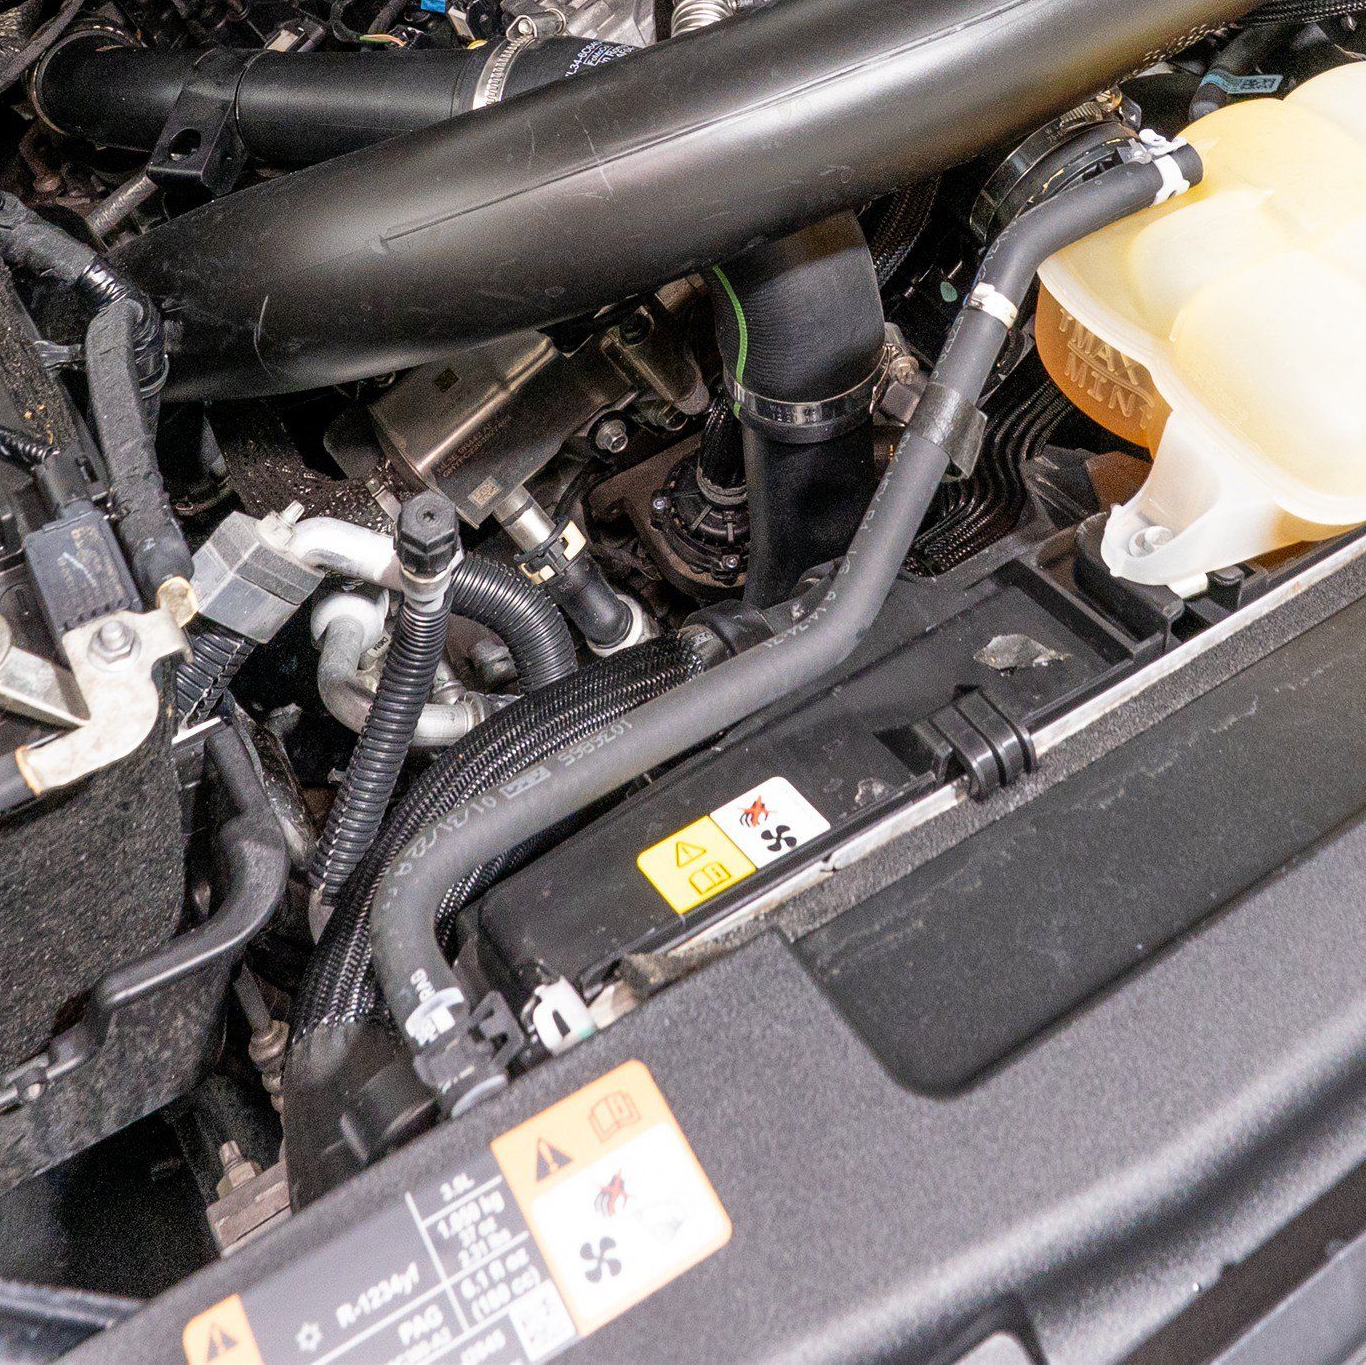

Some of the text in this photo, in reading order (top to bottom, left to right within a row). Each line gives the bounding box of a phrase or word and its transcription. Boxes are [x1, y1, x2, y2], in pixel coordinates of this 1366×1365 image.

[1064, 351, 1137, 417] MIN
[333, 1260, 425, 1329] R-1234yf
[397, 1303, 445, 1346] PAG
